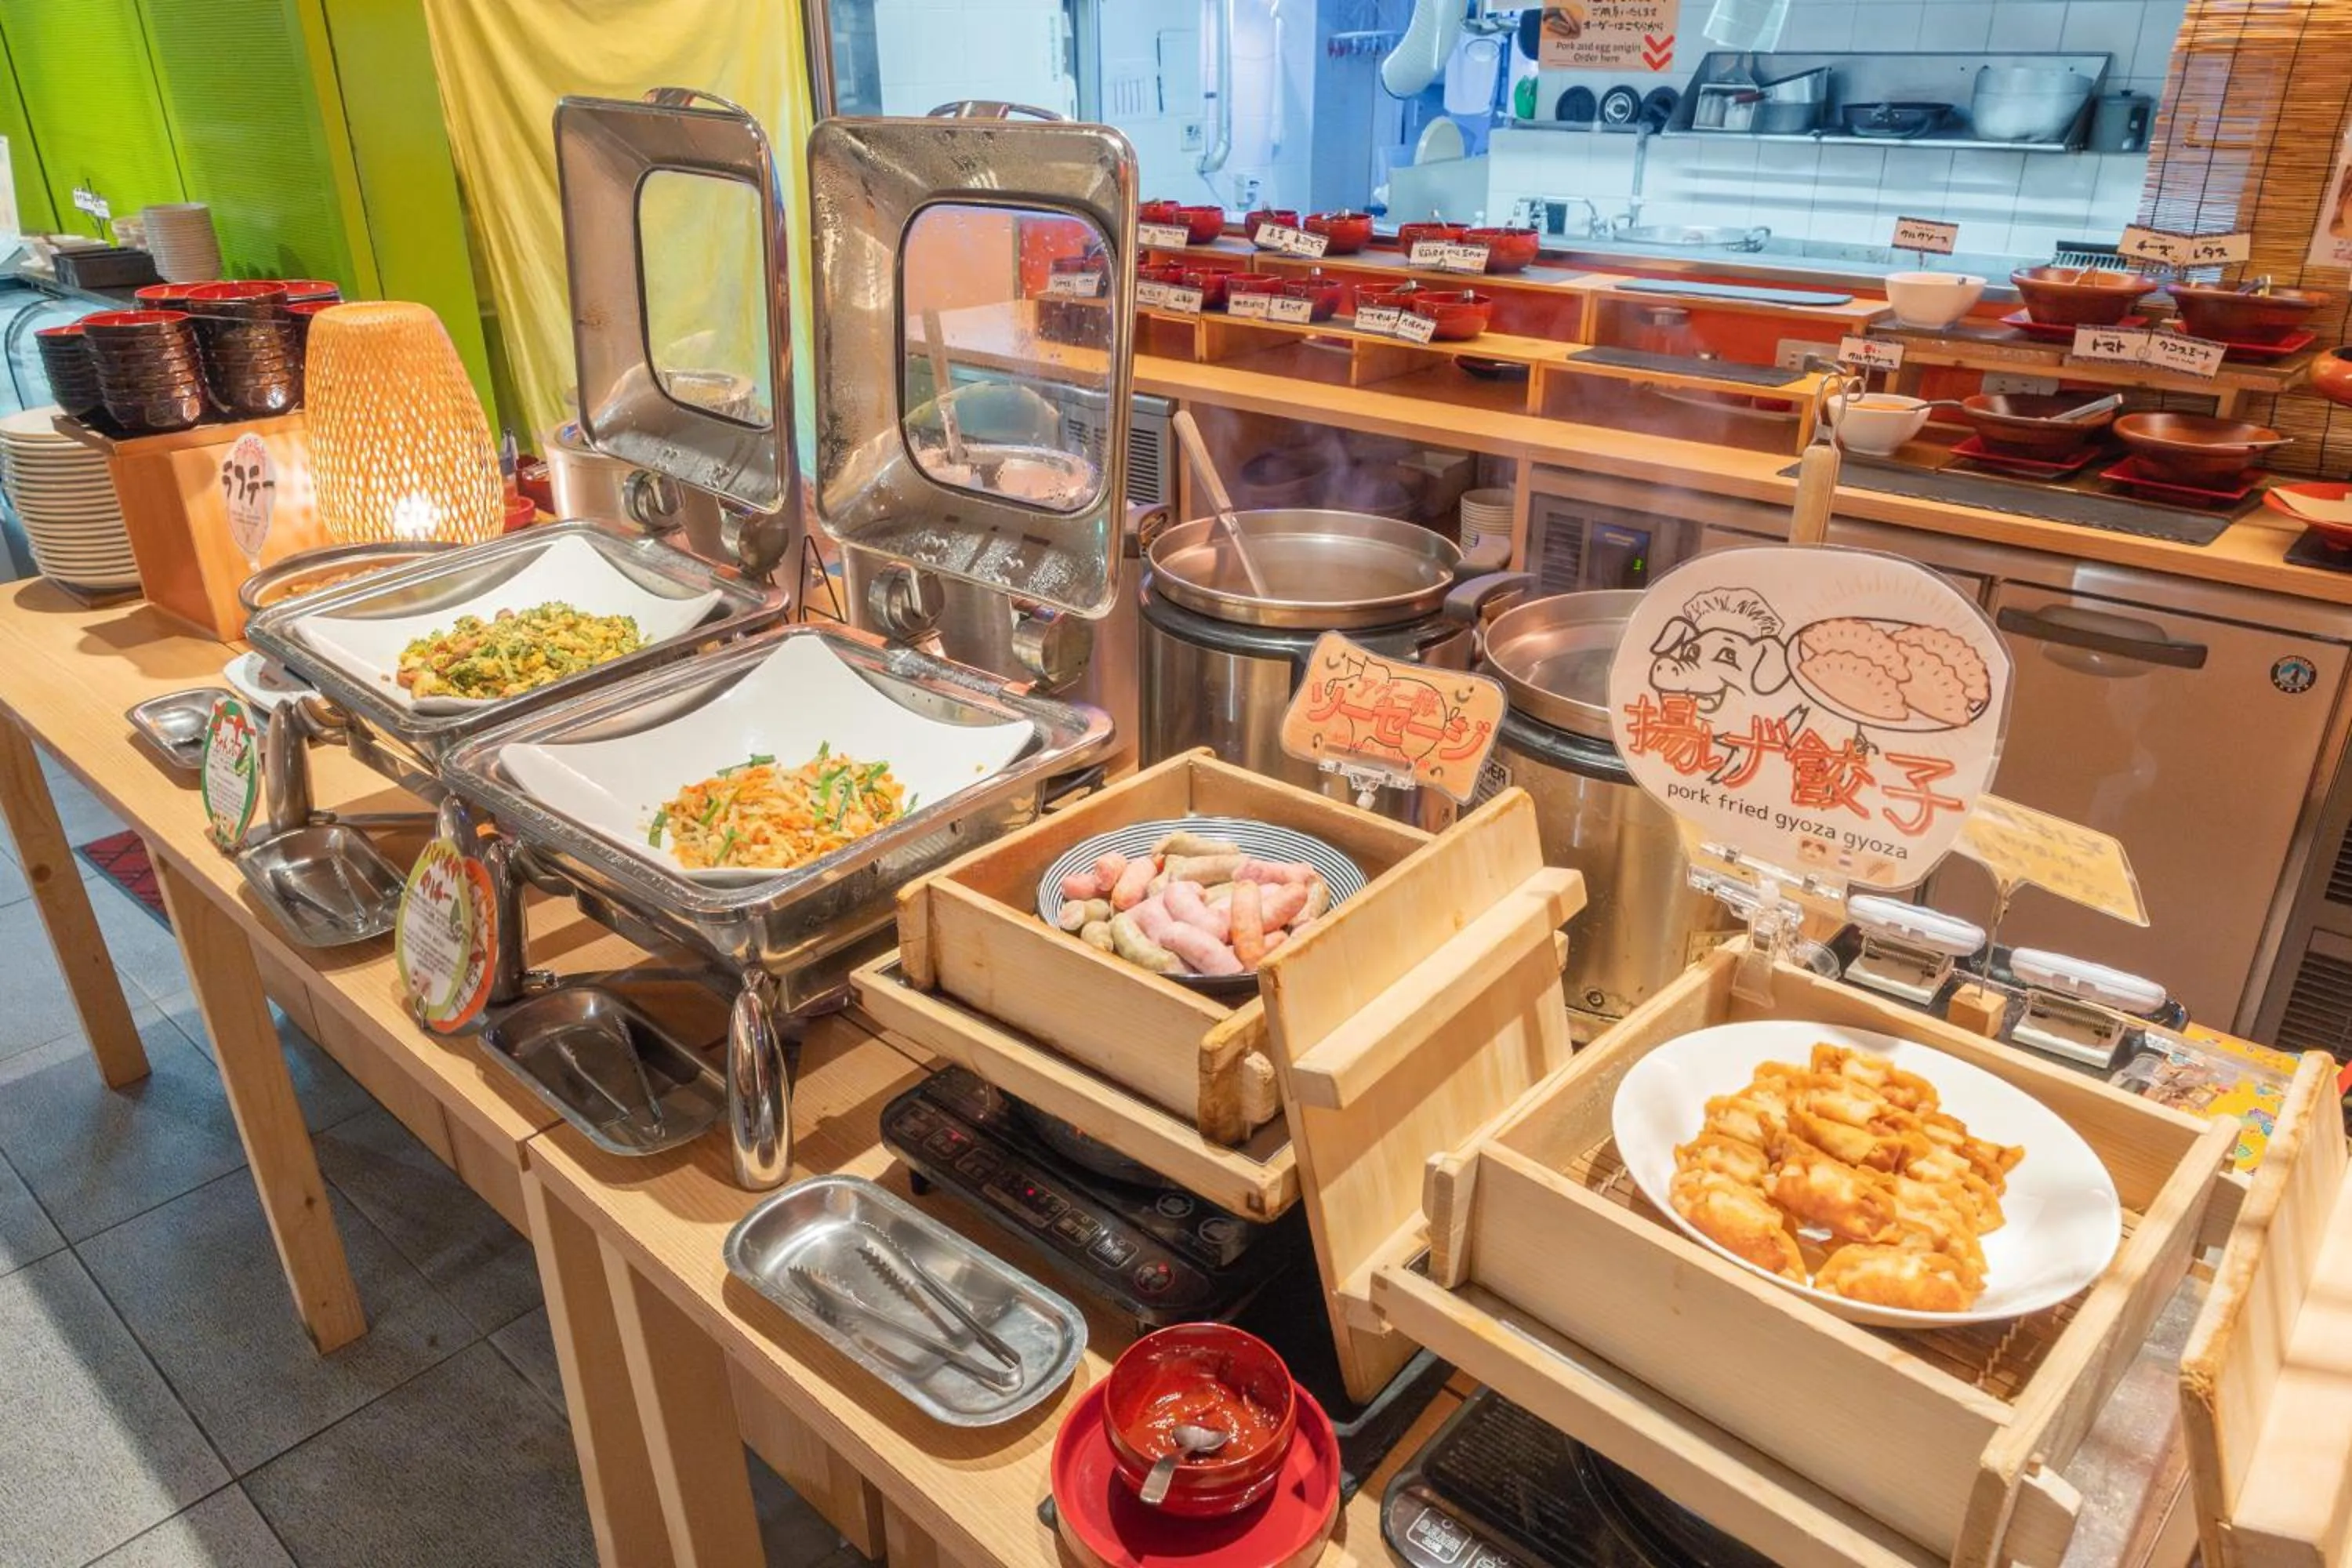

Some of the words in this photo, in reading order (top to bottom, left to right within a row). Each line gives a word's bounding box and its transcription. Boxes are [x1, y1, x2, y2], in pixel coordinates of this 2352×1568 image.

[1556, 42, 1575, 51] Pork
[1577, 42, 1594, 51] and
[1595, 43, 1610, 53] egg
[1573, 53, 1599, 62] Order
[1600, 53, 1620, 63] here
[2136, 242, 2175, 257] チーズ
[2193, 245, 2227, 259] レタス
[2092, 338, 2126, 353] トマト
[2159, 340, 2212, 360] タコスミート
[1307, 681, 1492, 760] ソーセージ
[1624, 692, 1965, 836] 揚げ餃子
[1667, 782, 1711, 806] pork
[1718, 793, 1769, 822] fried
[1774, 812, 1837, 841] gyoza
[1843, 829, 1909, 862] gyoza
